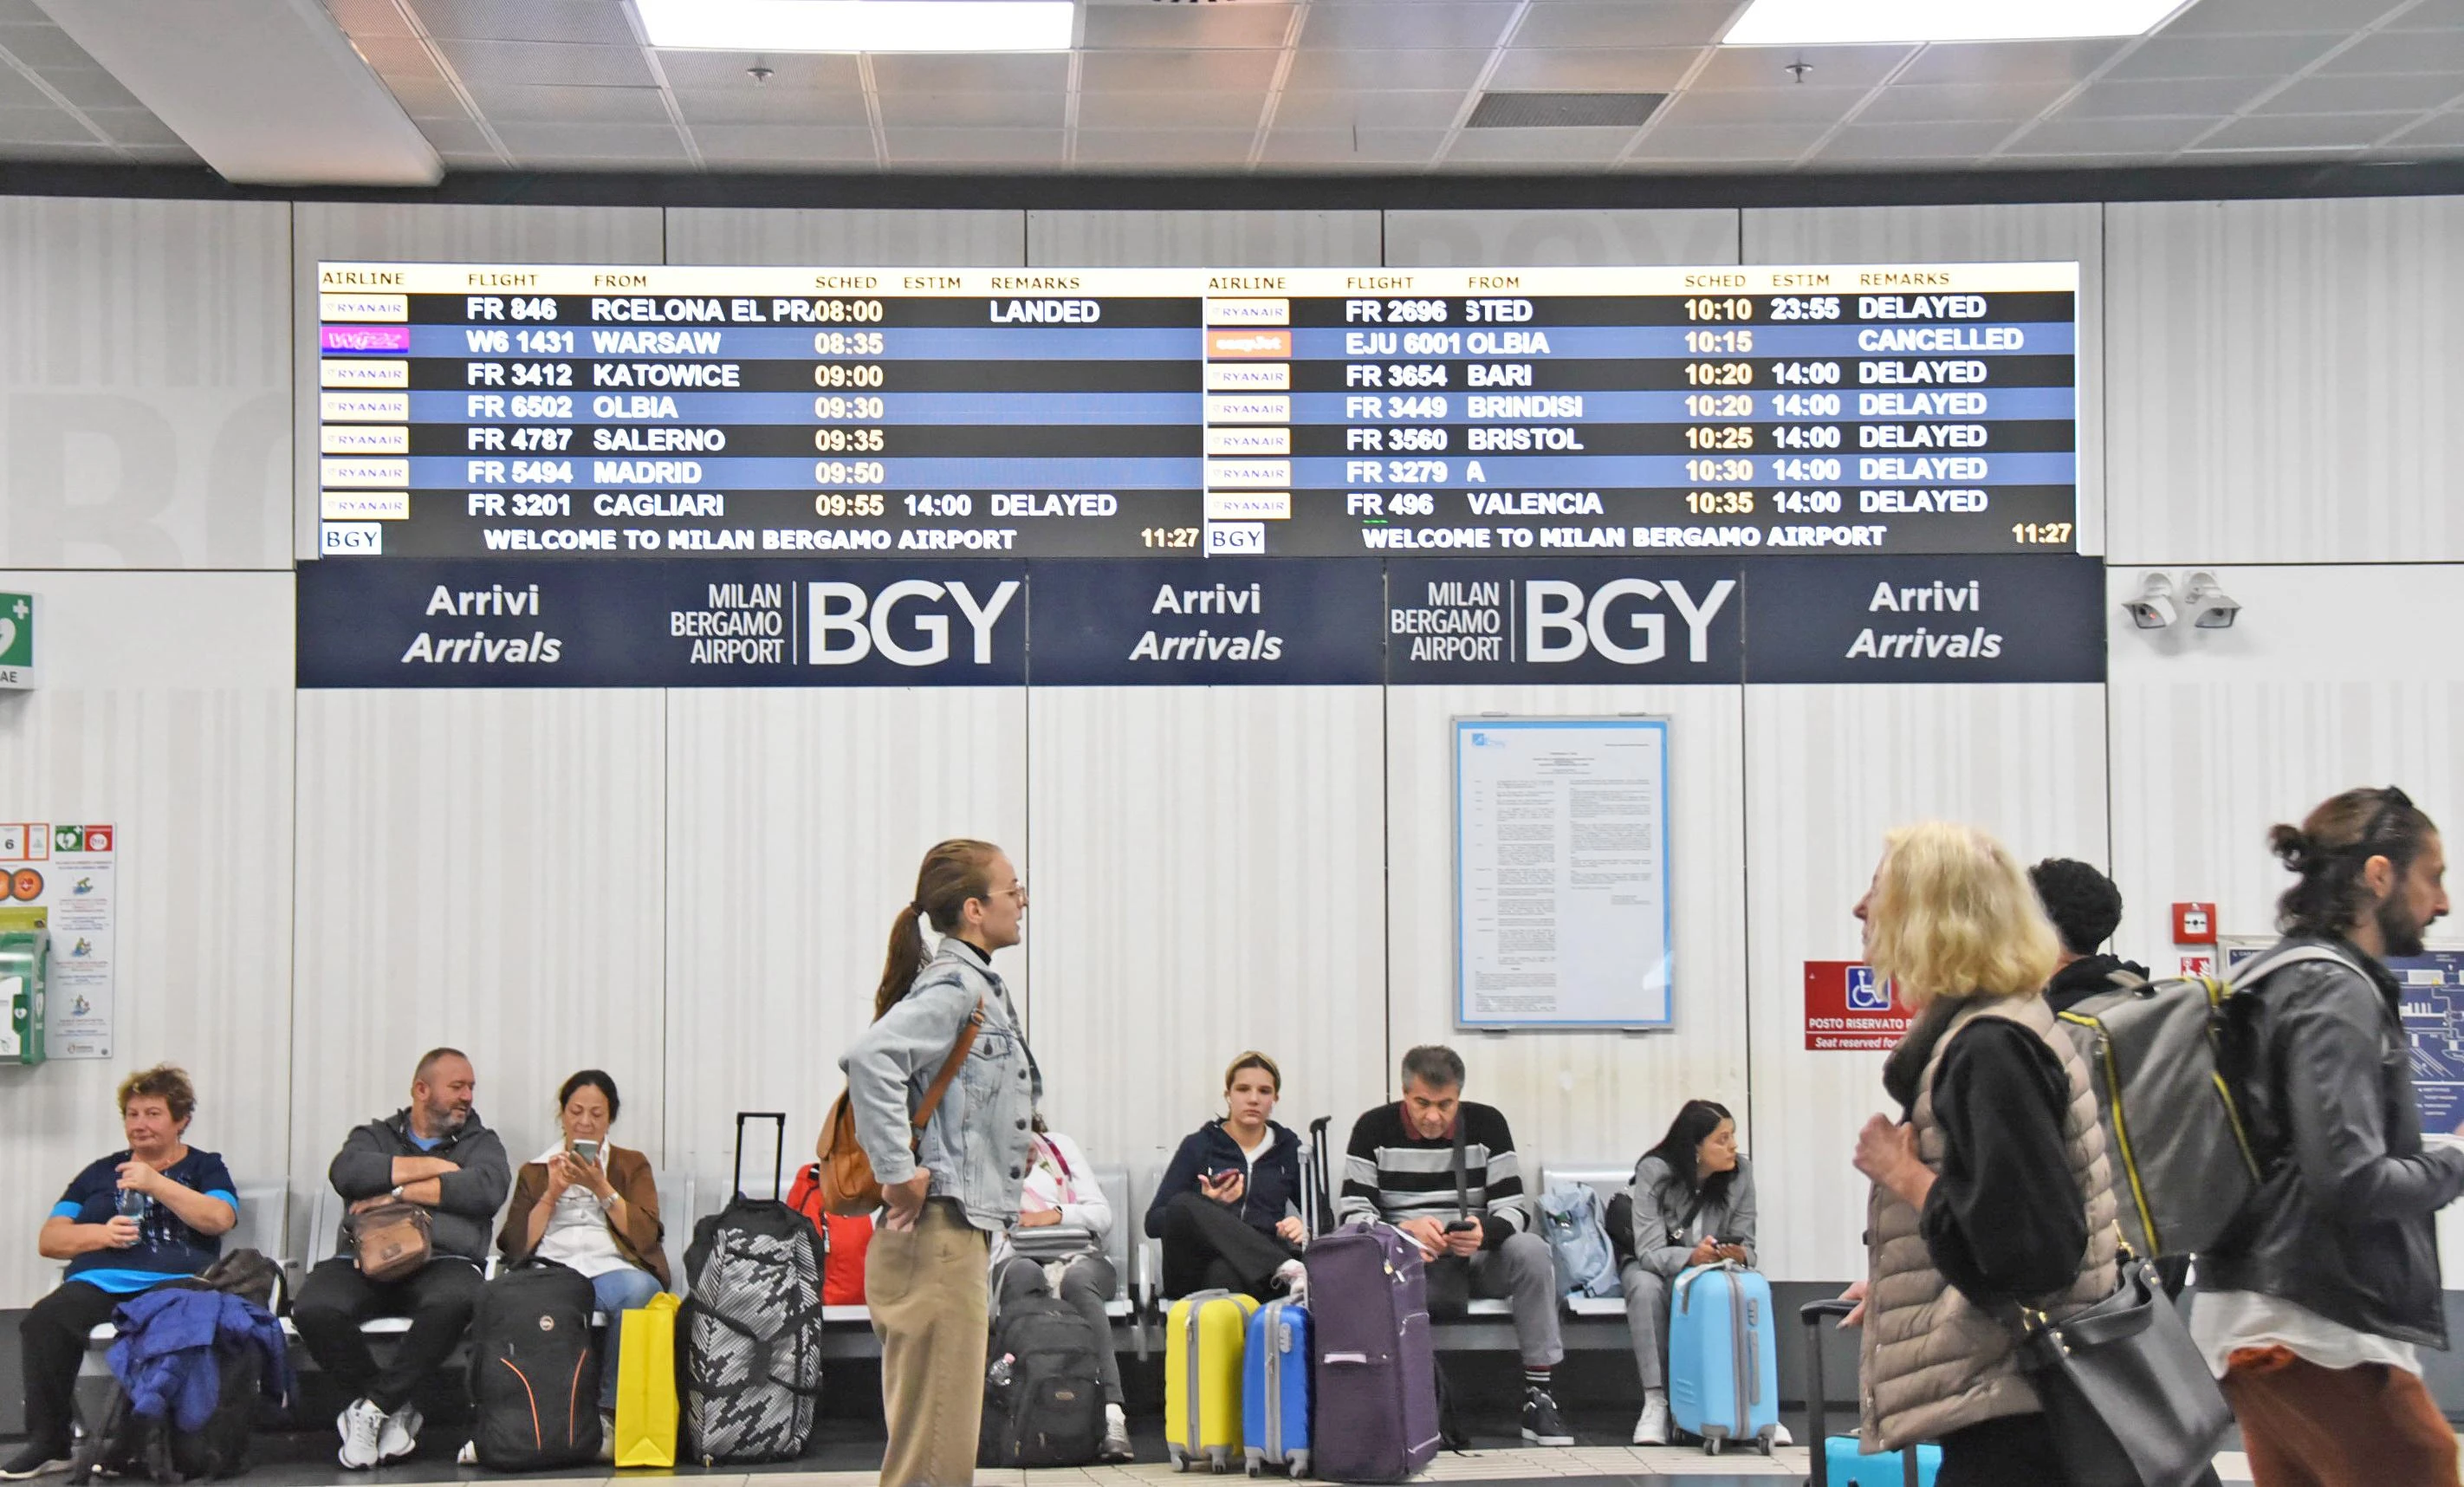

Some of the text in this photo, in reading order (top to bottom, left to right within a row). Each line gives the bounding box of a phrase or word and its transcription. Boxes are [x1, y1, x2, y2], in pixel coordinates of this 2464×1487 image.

[323, 272, 1080, 289] AIRLINE FLIGHT FROM SCHED ESTIM REMARKS
[1209, 273, 1949, 289] AIRLINE FLIGHT FROM SCHED ESTIM REMARKS
[468, 297, 504, 320] FR
[511, 298, 556, 320] 846
[593, 299, 725, 321] RCELONA
[732, 300, 766, 321] EL
[774, 300, 814, 321] PR
[815, 301, 882, 321] 08:00
[991, 301, 1099, 322] LANDED
[1346, 301, 1382, 321] FR
[1388, 301, 1447, 321] 2696
[1685, 299, 1751, 320] 10:10
[1771, 297, 1839, 320] 23:55
[1859, 296, 1986, 319] DELAYED
[466, 330, 509, 353] W6
[516, 331, 574, 353] 1431
[592, 331, 721, 354] WARSAW
[815, 333, 883, 354] 08:35
[1346, 328, 2024, 354] EJU 6001 OLBIA 10:15 CANCELLED
[469, 363, 505, 385] FR
[512, 364, 572, 386] 3412
[594, 364, 740, 386] KATOWICE
[815, 366, 883, 386] 09:00
[1347, 366, 1382, 386] FR
[1389, 365, 1448, 386] 3654
[1468, 365, 1531, 386] BARI
[1685, 364, 1752, 385] 10:20
[1772, 362, 1839, 384] 14:00
[1859, 361, 1987, 383] DELAYED
[468, 395, 506, 417] FR
[511, 395, 573, 418] 6502
[593, 396, 679, 418] OLBIA
[815, 397, 883, 419] 09:30
[1346, 397, 1383, 419] FR
[1388, 396, 1448, 418] 3449
[1468, 396, 1583, 418] BRINDISI
[1685, 395, 1753, 416] 10:20
[1772, 394, 1840, 416] 14:00
[1859, 393, 1987, 415] DELAYED
[469, 428, 505, 450] FR
[511, 429, 572, 450] 4787
[593, 429, 725, 451] SALERNO
[815, 430, 884, 451] 09:35
[1347, 429, 1383, 450] FR
[1389, 429, 1447, 450] 3560
[1469, 428, 1584, 450] BRISTOL
[1686, 427, 1753, 448] 10:25
[1773, 426, 1840, 448] 14:00
[1860, 425, 1987, 447] DELAYED
[468, 461, 506, 483] FR
[512, 461, 574, 484] 5494
[594, 461, 702, 484] MADRID
[815, 462, 884, 484] 09:50
[1347, 461, 1384, 483] FR
[1389, 461, 1448, 483] 3279
[1467, 461, 1486, 482] A
[1686, 459, 1753, 481] 10:30
[1773, 458, 1841, 481] 14:00
[1860, 458, 1987, 480] DELAYED
[469, 494, 506, 516] FR
[512, 494, 569, 516] 3201
[594, 494, 723, 516] CAGLIARI
[816, 495, 884, 516] 09:55
[905, 495, 971, 516] 14:00
[992, 494, 1117, 516] DELAYED
[1348, 494, 1383, 515] FR
[1389, 494, 1433, 515] 496
[1468, 493, 1604, 515] VALENCIA
[1686, 492, 1753, 513] 10:35
[1773, 491, 1840, 513] 14:00
[1860, 490, 1987, 512] DELAYED
[327, 529, 1199, 549] BGY WELCOME TO MILAN BERGAMO AIRPORT 11:27
[1214, 523, 2072, 548] BGY WELCOME TO MILAN BERGAMO AIRPORT 11:27
[426, 585, 538, 615] Arrivi
[710, 584, 781, 607] MILAN
[1152, 584, 1260, 614] Arrivi
[1429, 582, 1499, 606] MILAN
[1870, 581, 1978, 611] Arrivi
[671, 612, 781, 635] BERGAMO
[809, 581, 1020, 666] BGY
[1392, 609, 1500, 633] BERGAMO
[1527, 579, 1735, 664] BGY
[402, 632, 561, 662] Arrivals
[691, 640, 784, 663] AIRPORT
[1129, 630, 1282, 659] Arrivals
[1410, 637, 1502, 660] AIRPORT
[1846, 627, 2002, 658] Arrivals
[5, 839, 15, 850] 6
[1809, 1019, 1844, 1029] POSTO
[1846, 1019, 1903, 1029] RISERVATO
[1815, 1038, 1837, 1047] Seat
[1839, 1038, 1881, 1048] reserved
